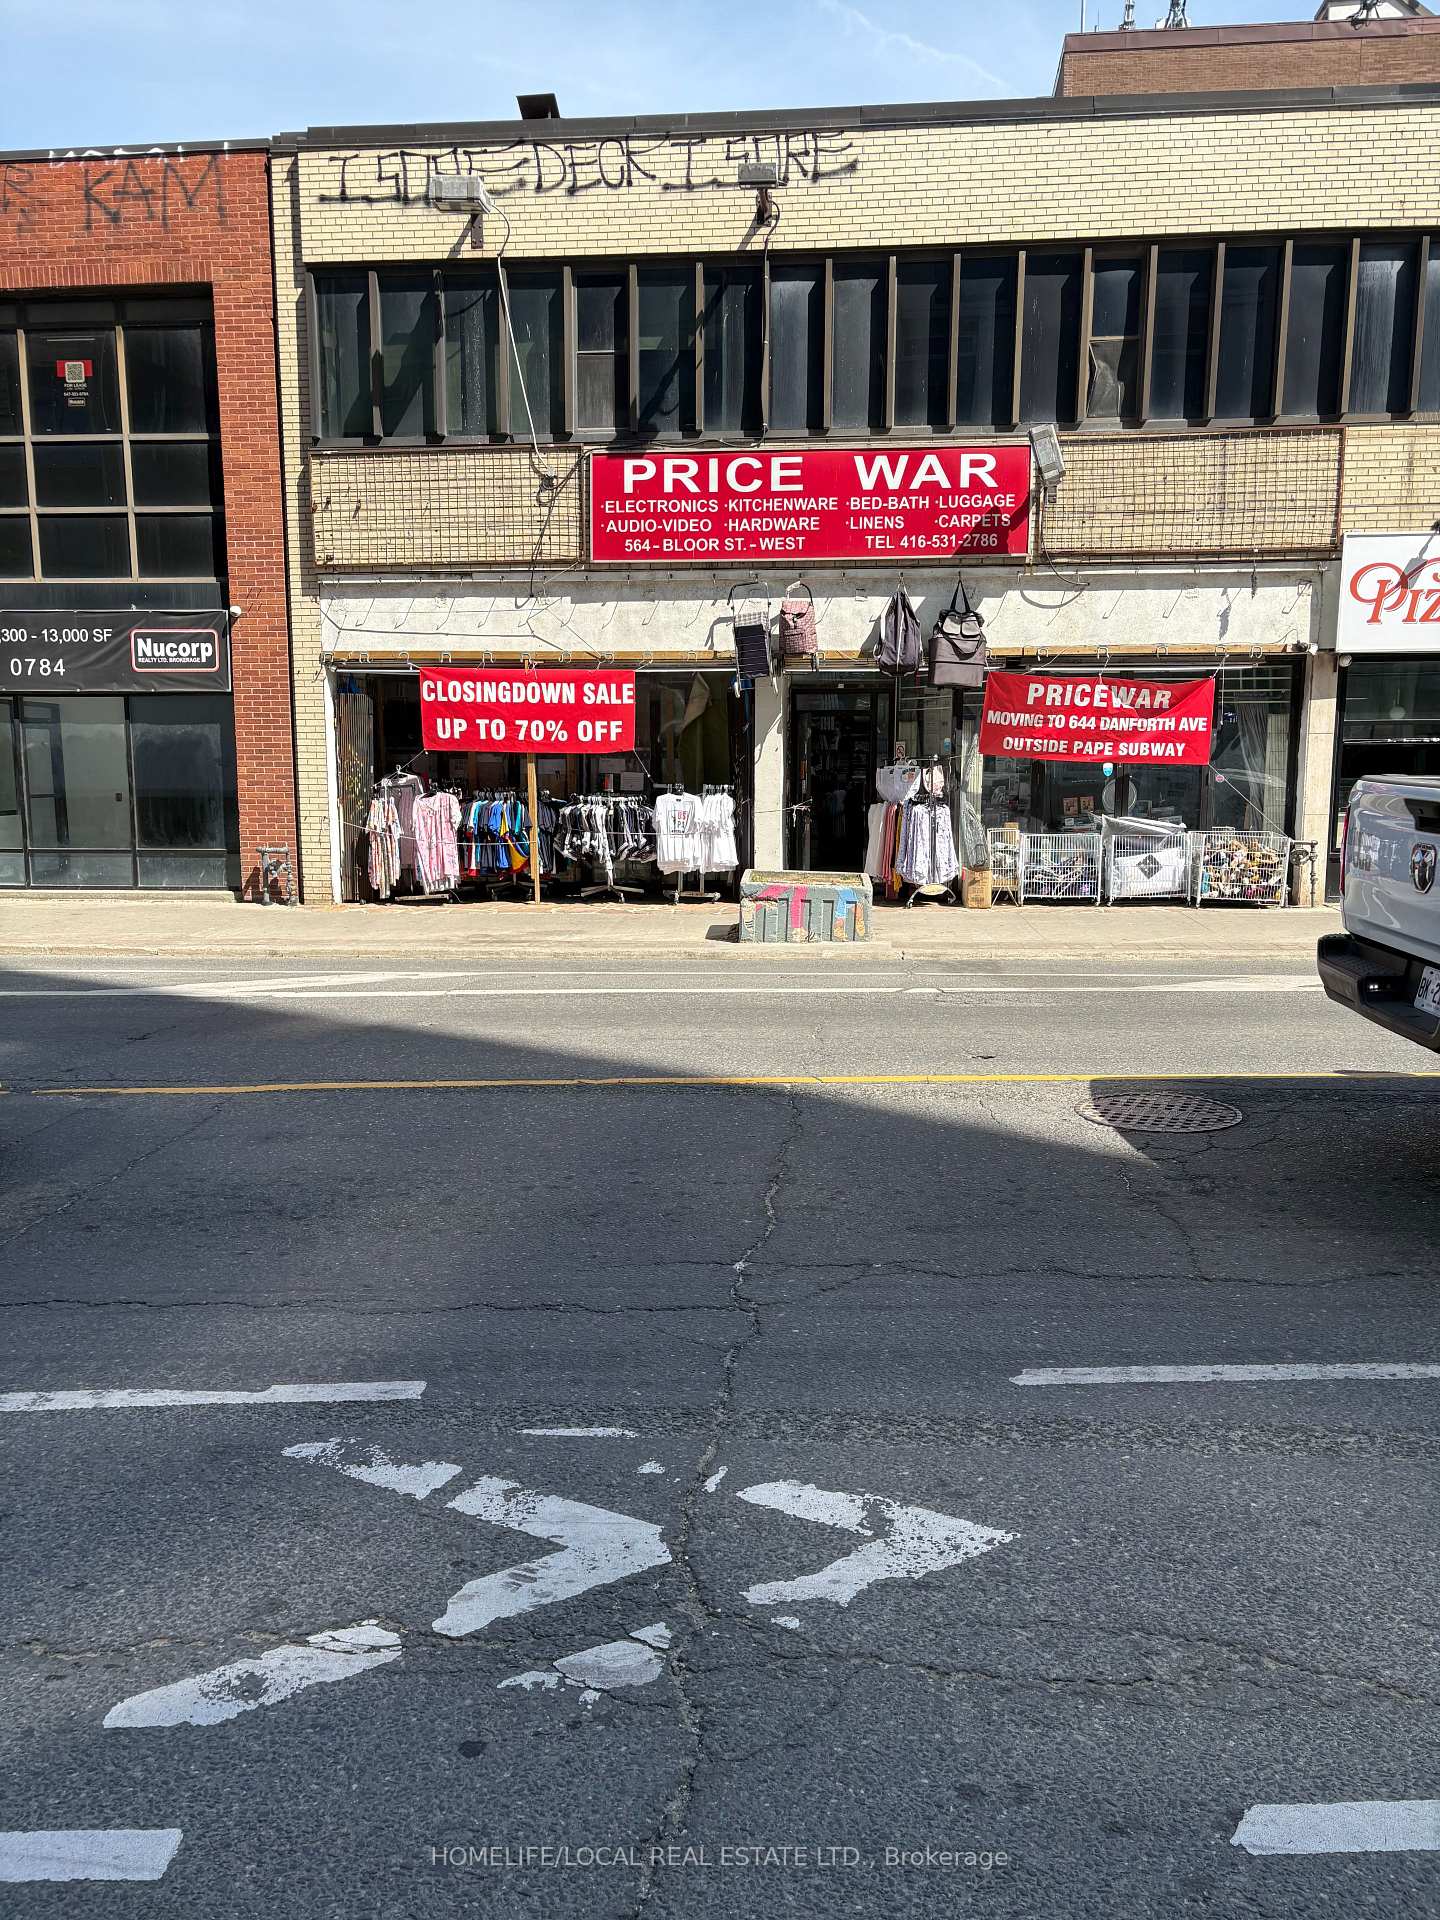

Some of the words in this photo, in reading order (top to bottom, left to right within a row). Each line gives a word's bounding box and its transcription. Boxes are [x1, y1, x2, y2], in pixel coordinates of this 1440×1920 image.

[623, 456, 804, 494] PRICE
[853, 453, 999, 491] WAR
[605, 499, 719, 514] ELECTRONICS
[728, 497, 838, 512] KITCHENWARE
[850, 496, 929, 510] BED-BATH
[939, 494, 1016, 508] LUGGAGE
[606, 519, 712, 533] AUDIO-VIDEO
[728, 517, 820, 532] HARDWARE
[850, 516, 905, 530] LINENS
[938, 514, 1011, 528] CARPETS
[662, 538, 720, 552] BLOOR
[759, 537, 805, 550] WEST
[865, 535, 895, 549] TEL
[900, 534, 998, 548] 416-531-2786
[41, 628, 89, 644] 13,000
[92, 628, 113, 642] SF
[136, 638, 213, 663] Nucorp
[10, 658, 66, 676] 0784
[422, 680, 575, 704] CLOSINGDOWN
[583, 682, 635, 705] SALE
[1026, 682, 1172, 709] PRICEWAR
[986, 710, 1044, 728] MOVING
[1048, 714, 1066, 729] TO
[1069, 715, 1097, 730] 644
[1100, 716, 1175, 731] DANFORTH
[1179, 717, 1208, 732] AVE
[436, 718, 467, 739] UP
[476, 718, 506, 740] TO
[515, 719, 568, 742] 70%
[577, 720, 623, 742] OFF
[1002, 736, 1068, 754] OUTSIDE
[1073, 740, 1113, 756] PAPE
[1118, 742, 1186, 757] SUBWAY
